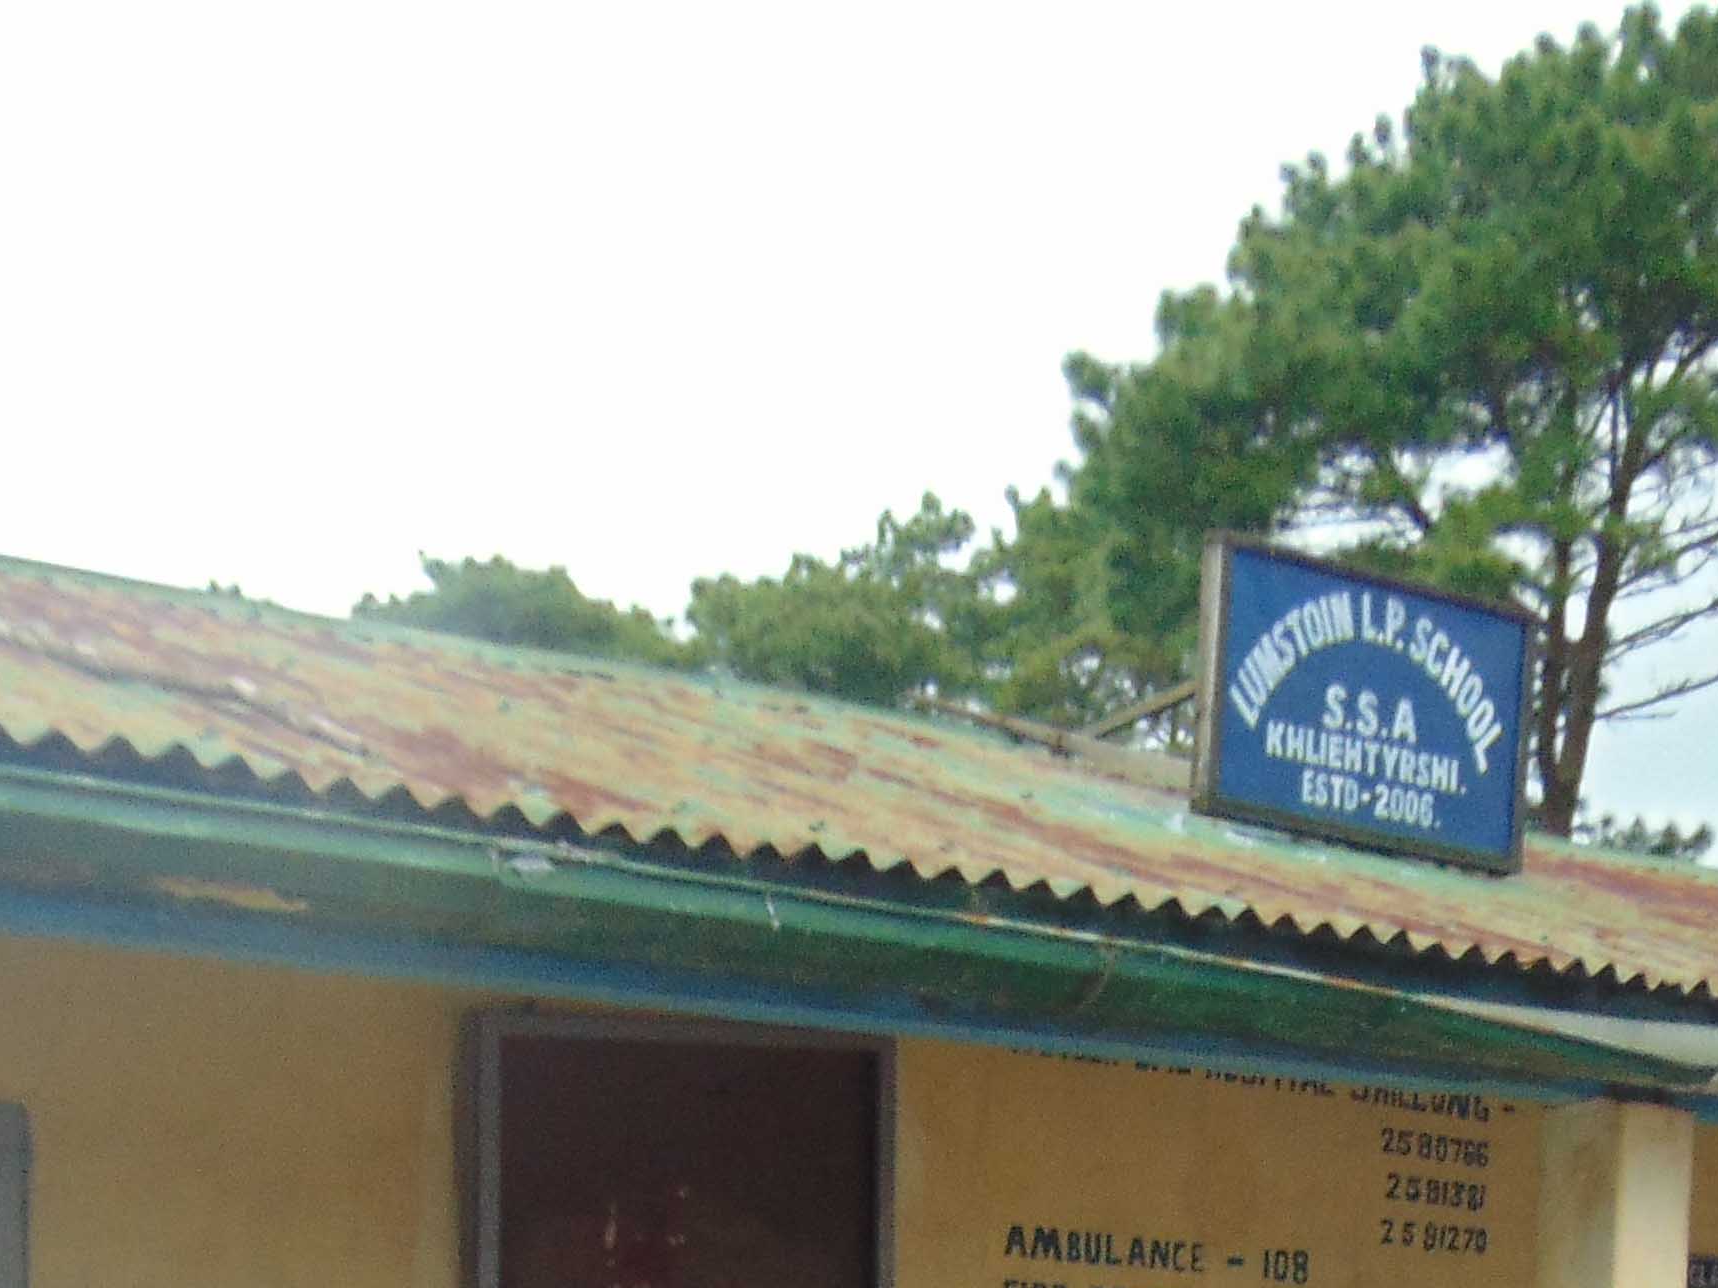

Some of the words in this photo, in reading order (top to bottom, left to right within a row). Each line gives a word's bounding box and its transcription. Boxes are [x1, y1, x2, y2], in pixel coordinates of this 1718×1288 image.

[1230, 591, 1355, 729] LUMSTOIN
[1410, 617, 1503, 774] SCHOOL
[1005, 1225, 1205, 1273] AMBULANCE
[1263, 1249, 1309, 1285] 108
